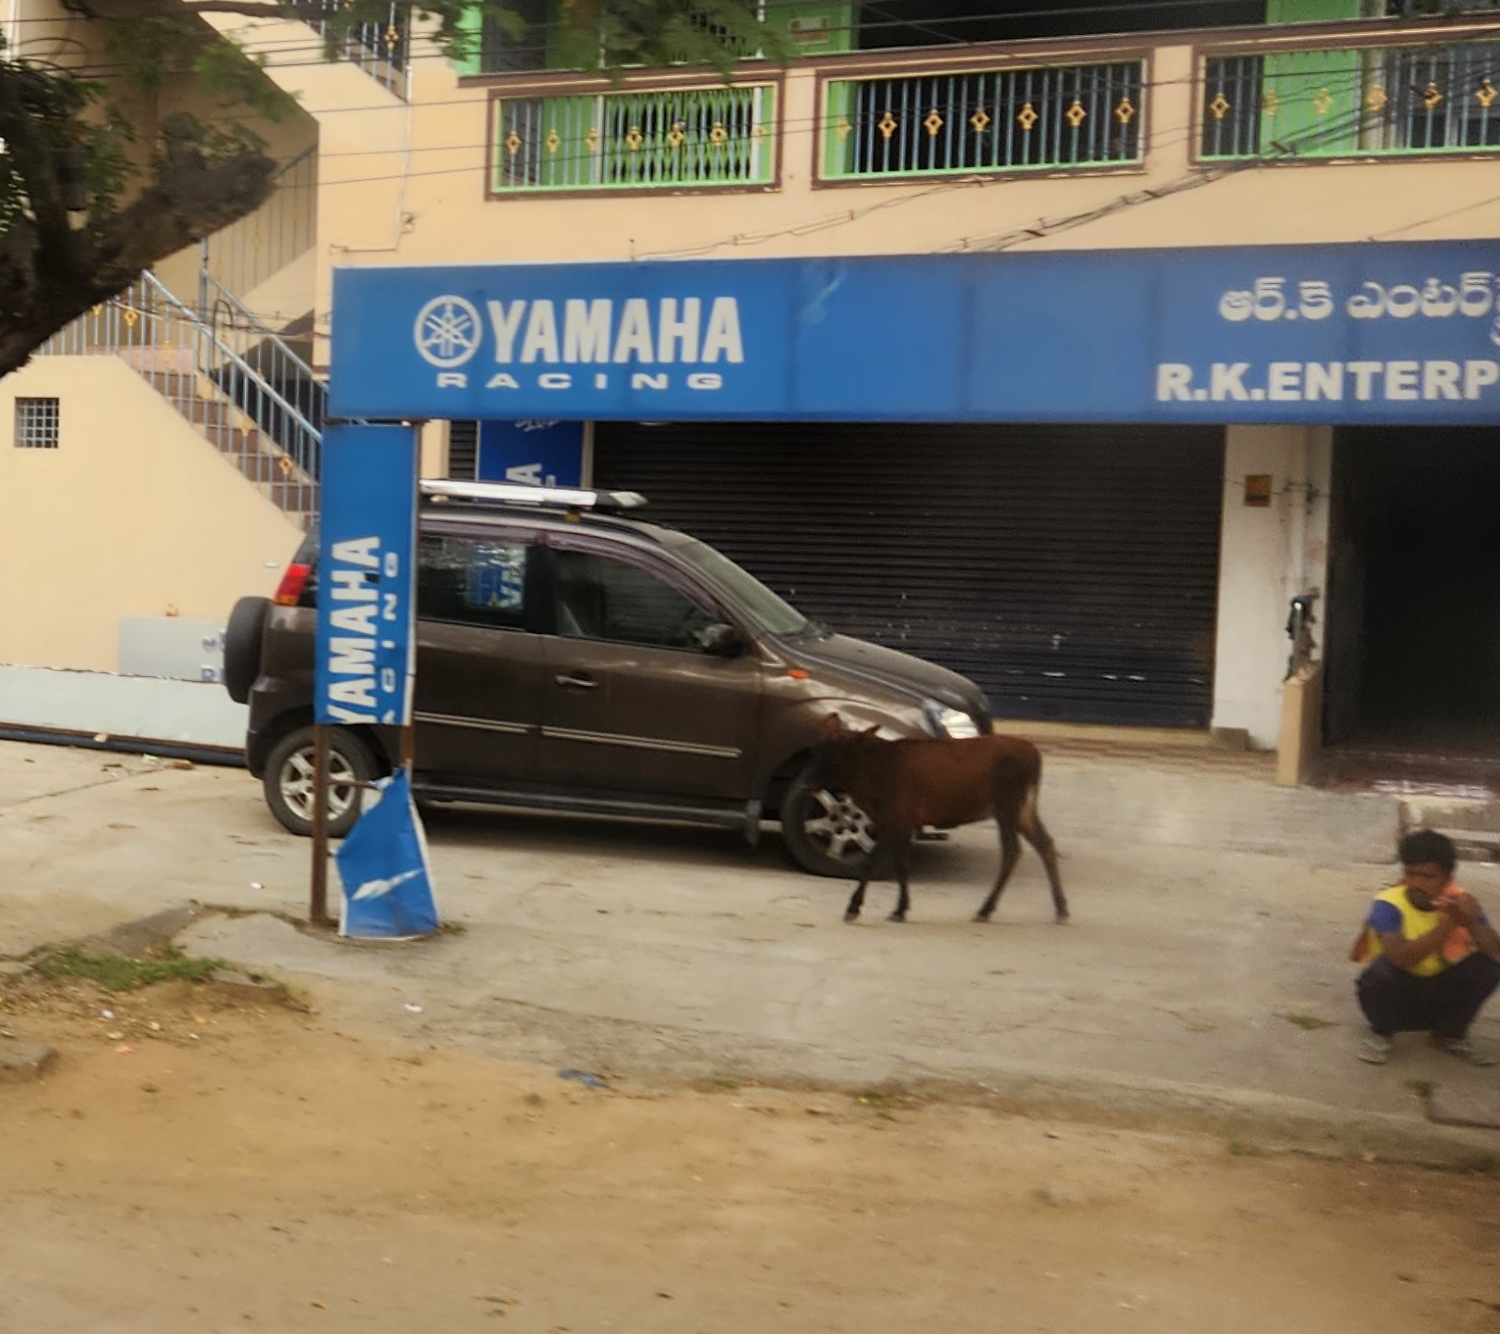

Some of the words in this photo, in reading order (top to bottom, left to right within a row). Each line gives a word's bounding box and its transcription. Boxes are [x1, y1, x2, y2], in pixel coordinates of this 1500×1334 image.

[487, 296, 745, 365] YAMAHA
[435, 372, 724, 391] RACING
[1155, 360, 1500, 402] R.K.ENTERP
[326, 535, 382, 725] YAMAHA
